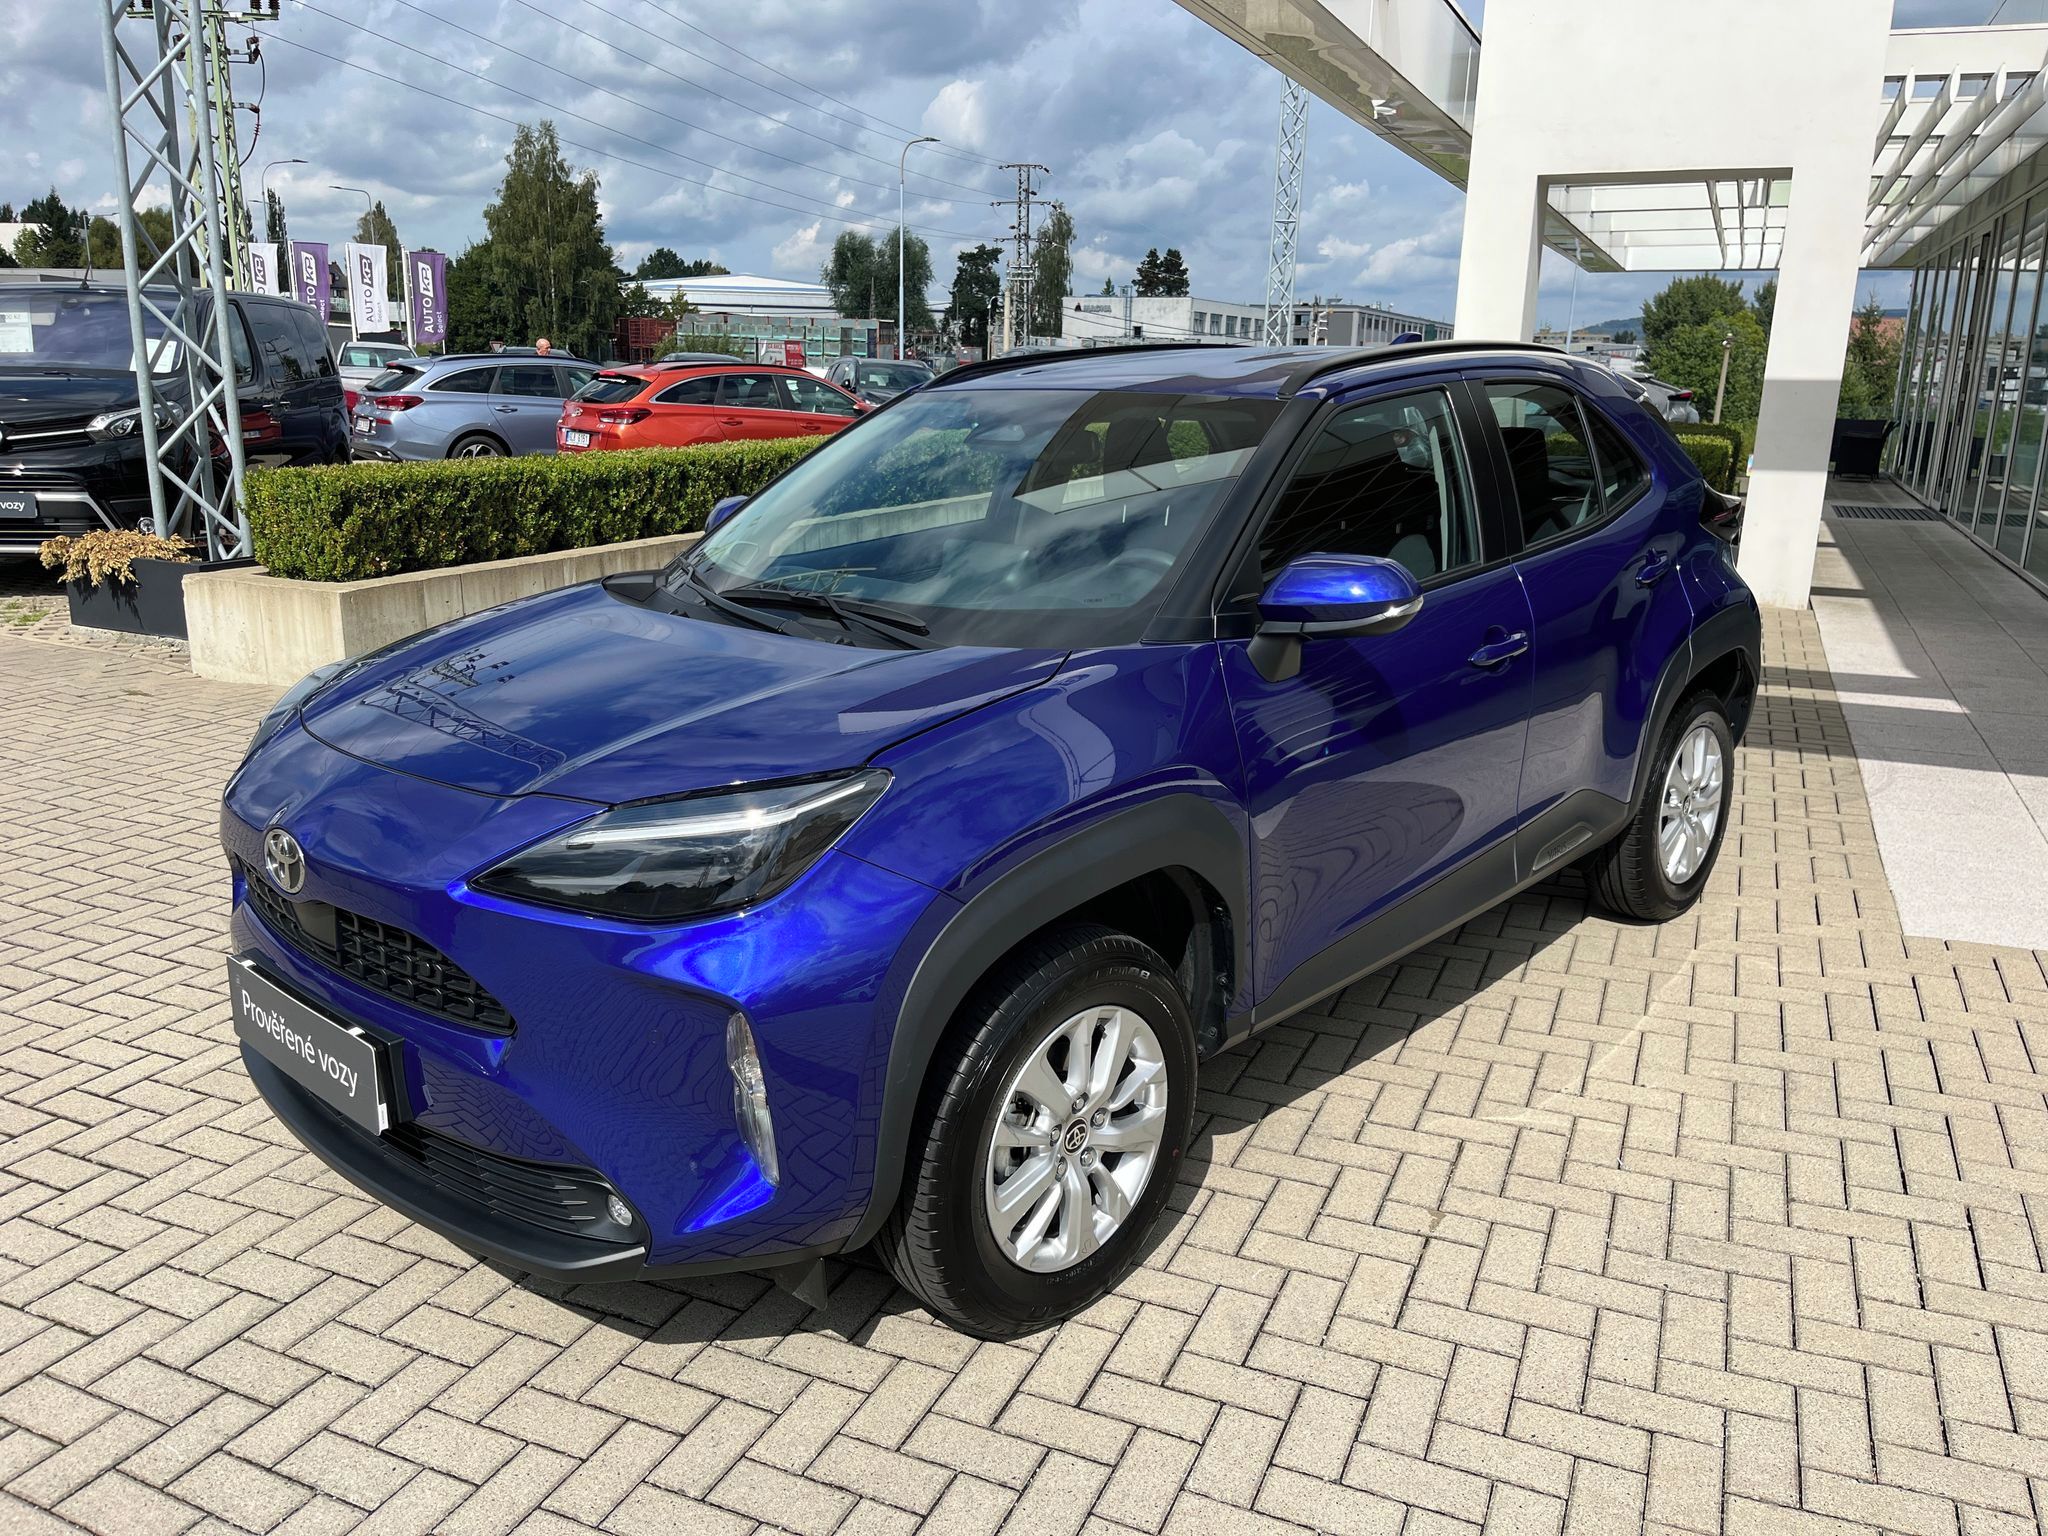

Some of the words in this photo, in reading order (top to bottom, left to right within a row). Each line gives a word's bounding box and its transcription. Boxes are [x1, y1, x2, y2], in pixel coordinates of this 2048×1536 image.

[364, 289, 374, 323] AUTO
[422, 297, 434, 333] AUTO
[436, 311, 444, 333] Select
[0, 501, 25, 511] vozy
[241, 989, 316, 1064] Prověřené
[318, 1048, 358, 1097] vozy
